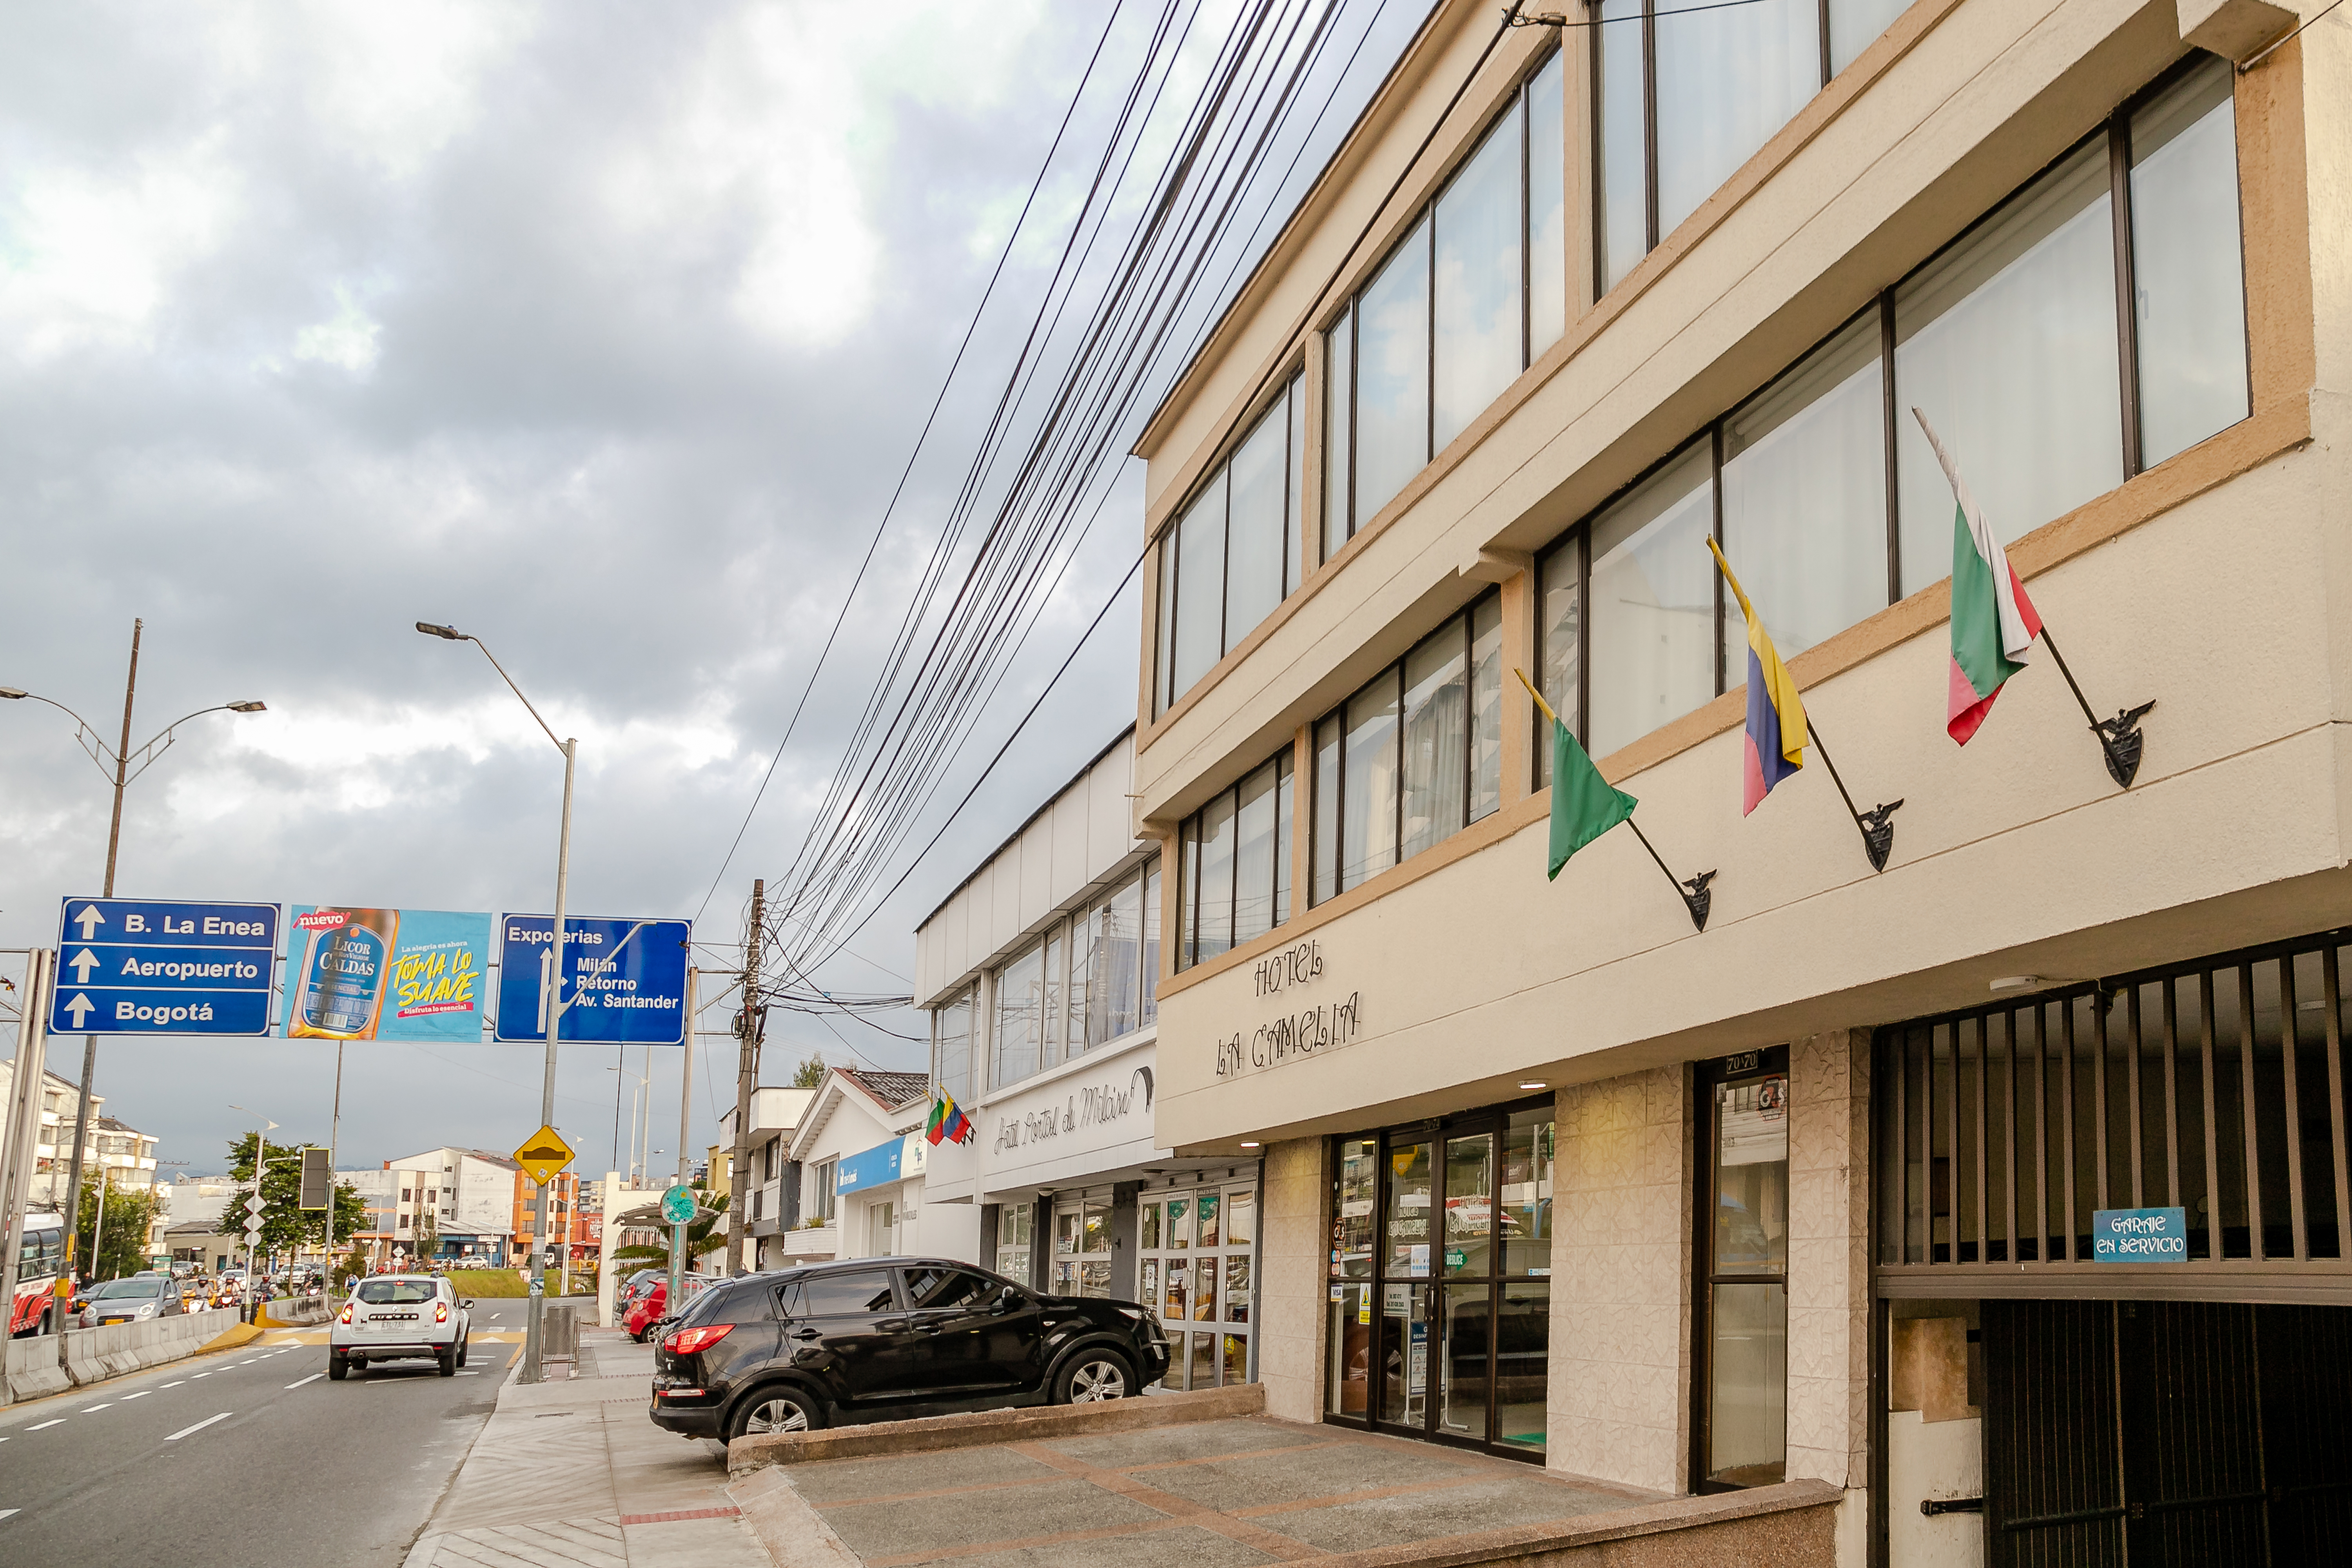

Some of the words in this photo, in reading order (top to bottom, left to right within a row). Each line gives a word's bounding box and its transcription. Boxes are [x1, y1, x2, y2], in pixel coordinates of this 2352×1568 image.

[125, 914, 152, 933] B.
[163, 915, 194, 934] La
[203, 916, 265, 936] Enea
[299, 915, 343, 926] nuevo
[508, 926, 603, 945] Expoerias
[334, 936, 371, 955] LICOR
[121, 958, 258, 981] Aeropuerto
[319, 952, 375, 976] CALDAS
[391, 952, 446, 988] TOMA
[452, 948, 473, 974] LO
[577, 957, 617, 973] Milán
[1254, 939, 1323, 997] HOTEL
[398, 971, 480, 1007] SUAVE
[576, 975, 637, 991] Retorno
[404, 1006, 432, 1014] Disfruta
[575, 993, 597, 1007] Av.
[603, 995, 679, 1009] Santander
[116, 1002, 213, 1024] Bogotá
[1216, 1033, 1240, 1076] LA
[1252, 992, 1359, 1067] CAMELIA
[994, 1117, 1019, 1155] Hotel
[1022, 1106, 1059, 1145] Portal
[1062, 1096, 1075, 1132] de
[1398, 1205, 1419, 1217] HOTEL
[2111, 1216, 2166, 1235] GARAJE
[2096, 1239, 2116, 1254] EN
[2118, 1237, 2184, 1254] SERVICIO
[1446, 1254, 1463, 1265] DESLICE
